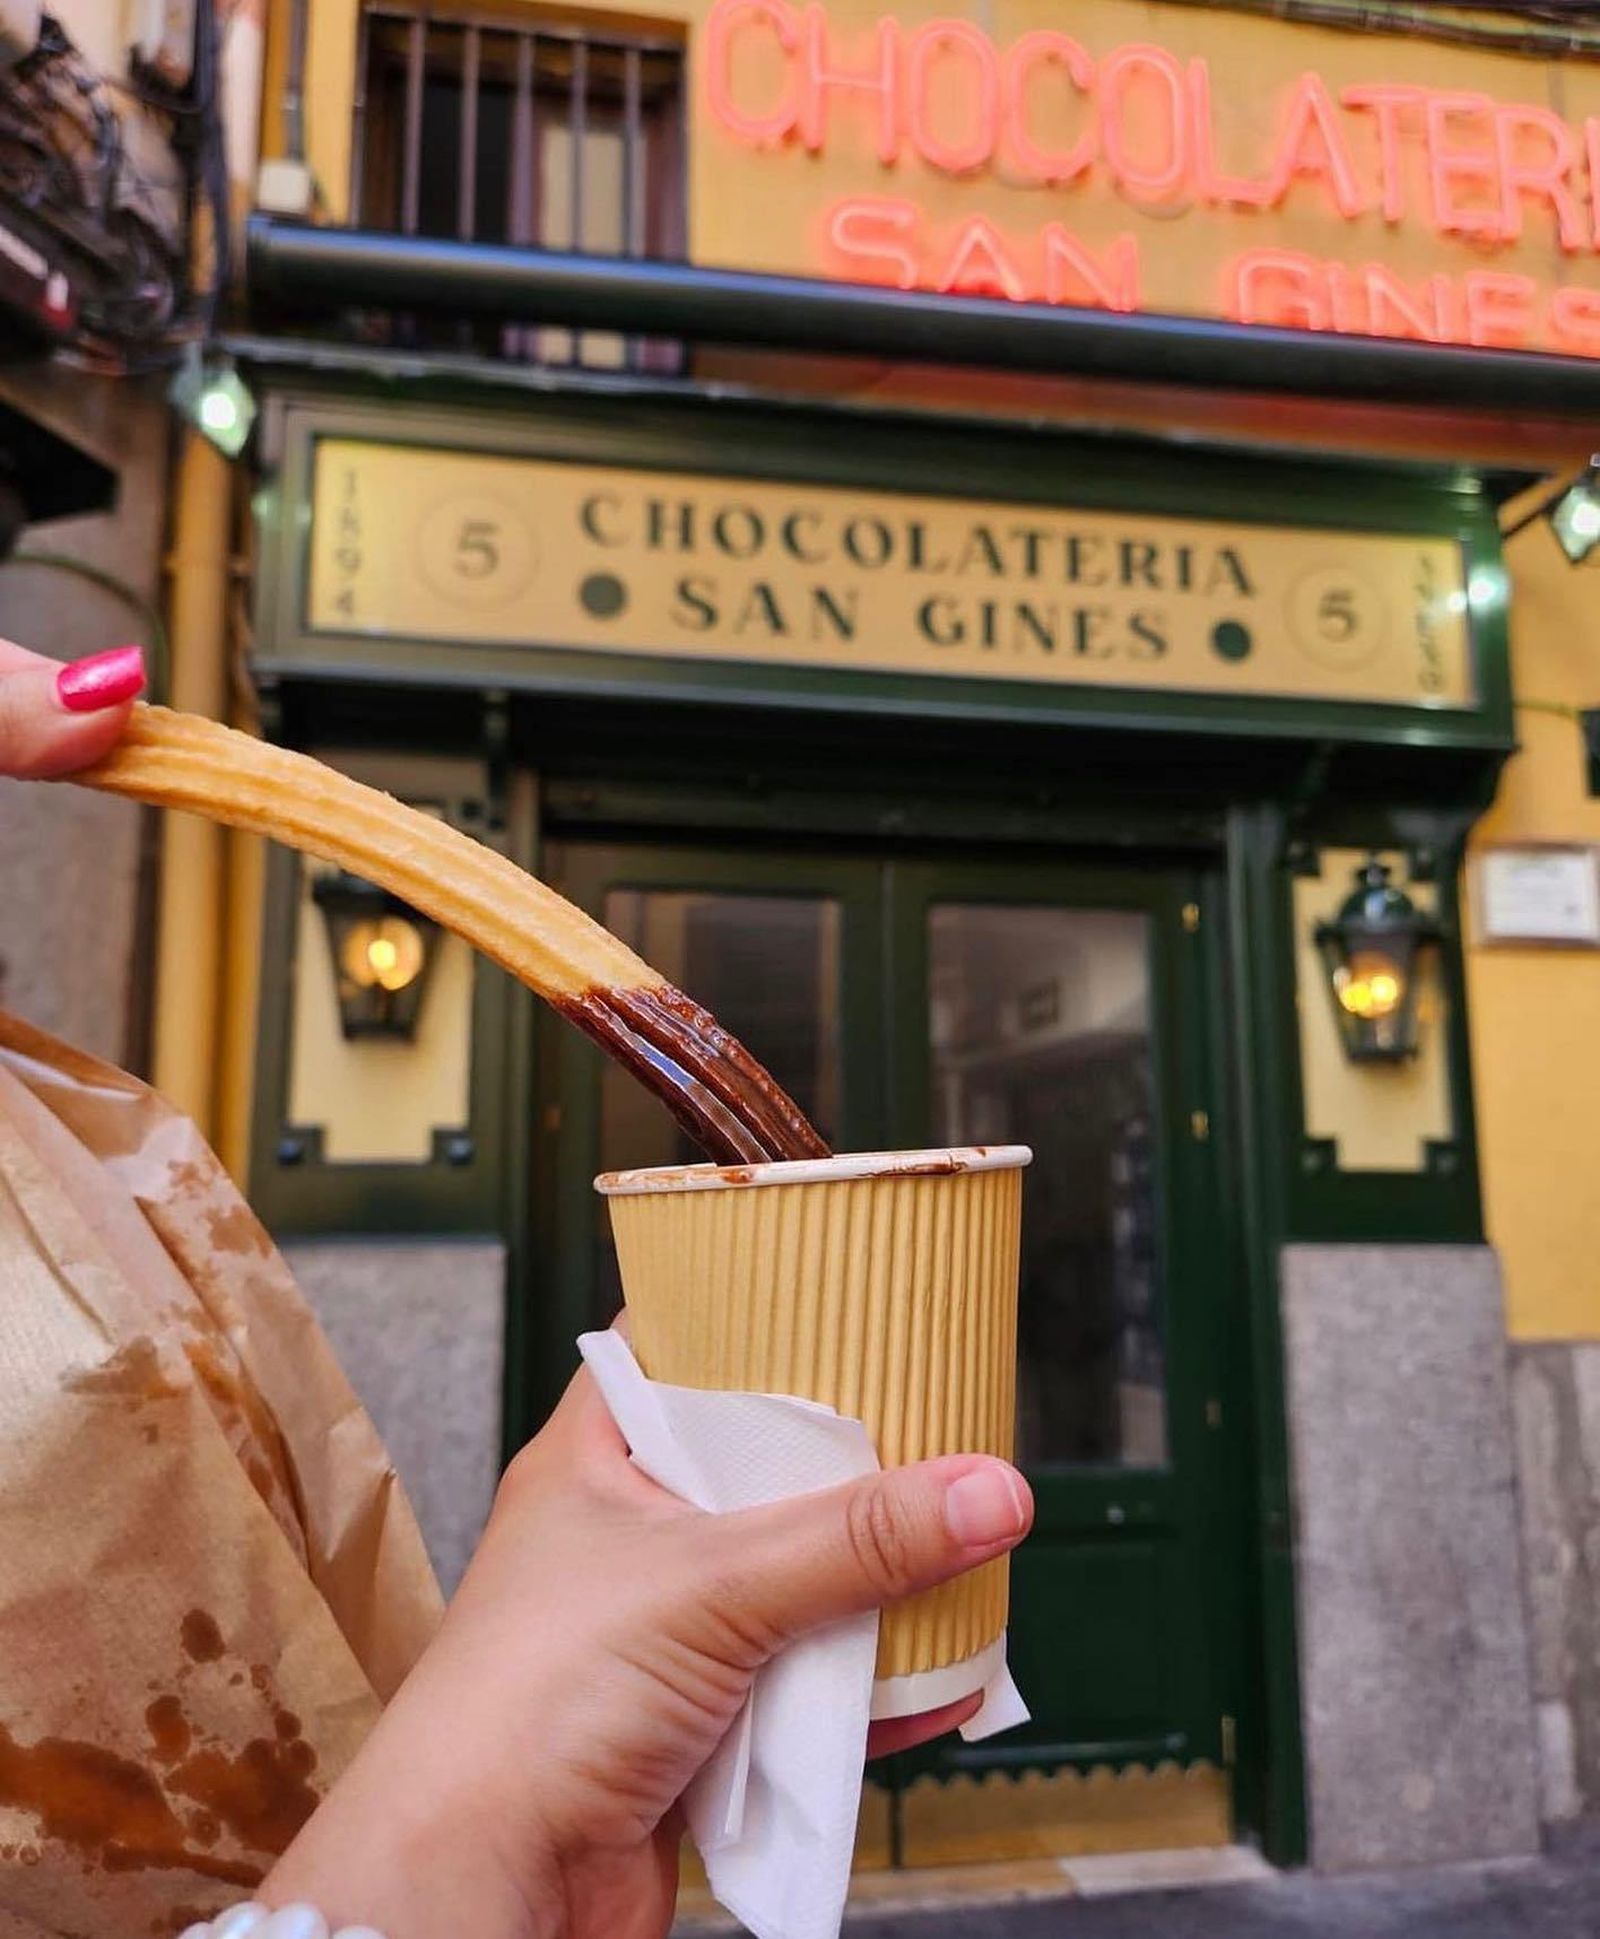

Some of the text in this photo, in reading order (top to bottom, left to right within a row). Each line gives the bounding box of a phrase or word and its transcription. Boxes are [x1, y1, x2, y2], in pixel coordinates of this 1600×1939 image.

[829, 202, 1141, 313] SAN
[452, 519, 499, 581] 5
[579, 490, 1256, 599] CHOCOLATERIA
[668, 574, 1169, 662] SAN GINES
[1315, 589, 1361, 643] 5
